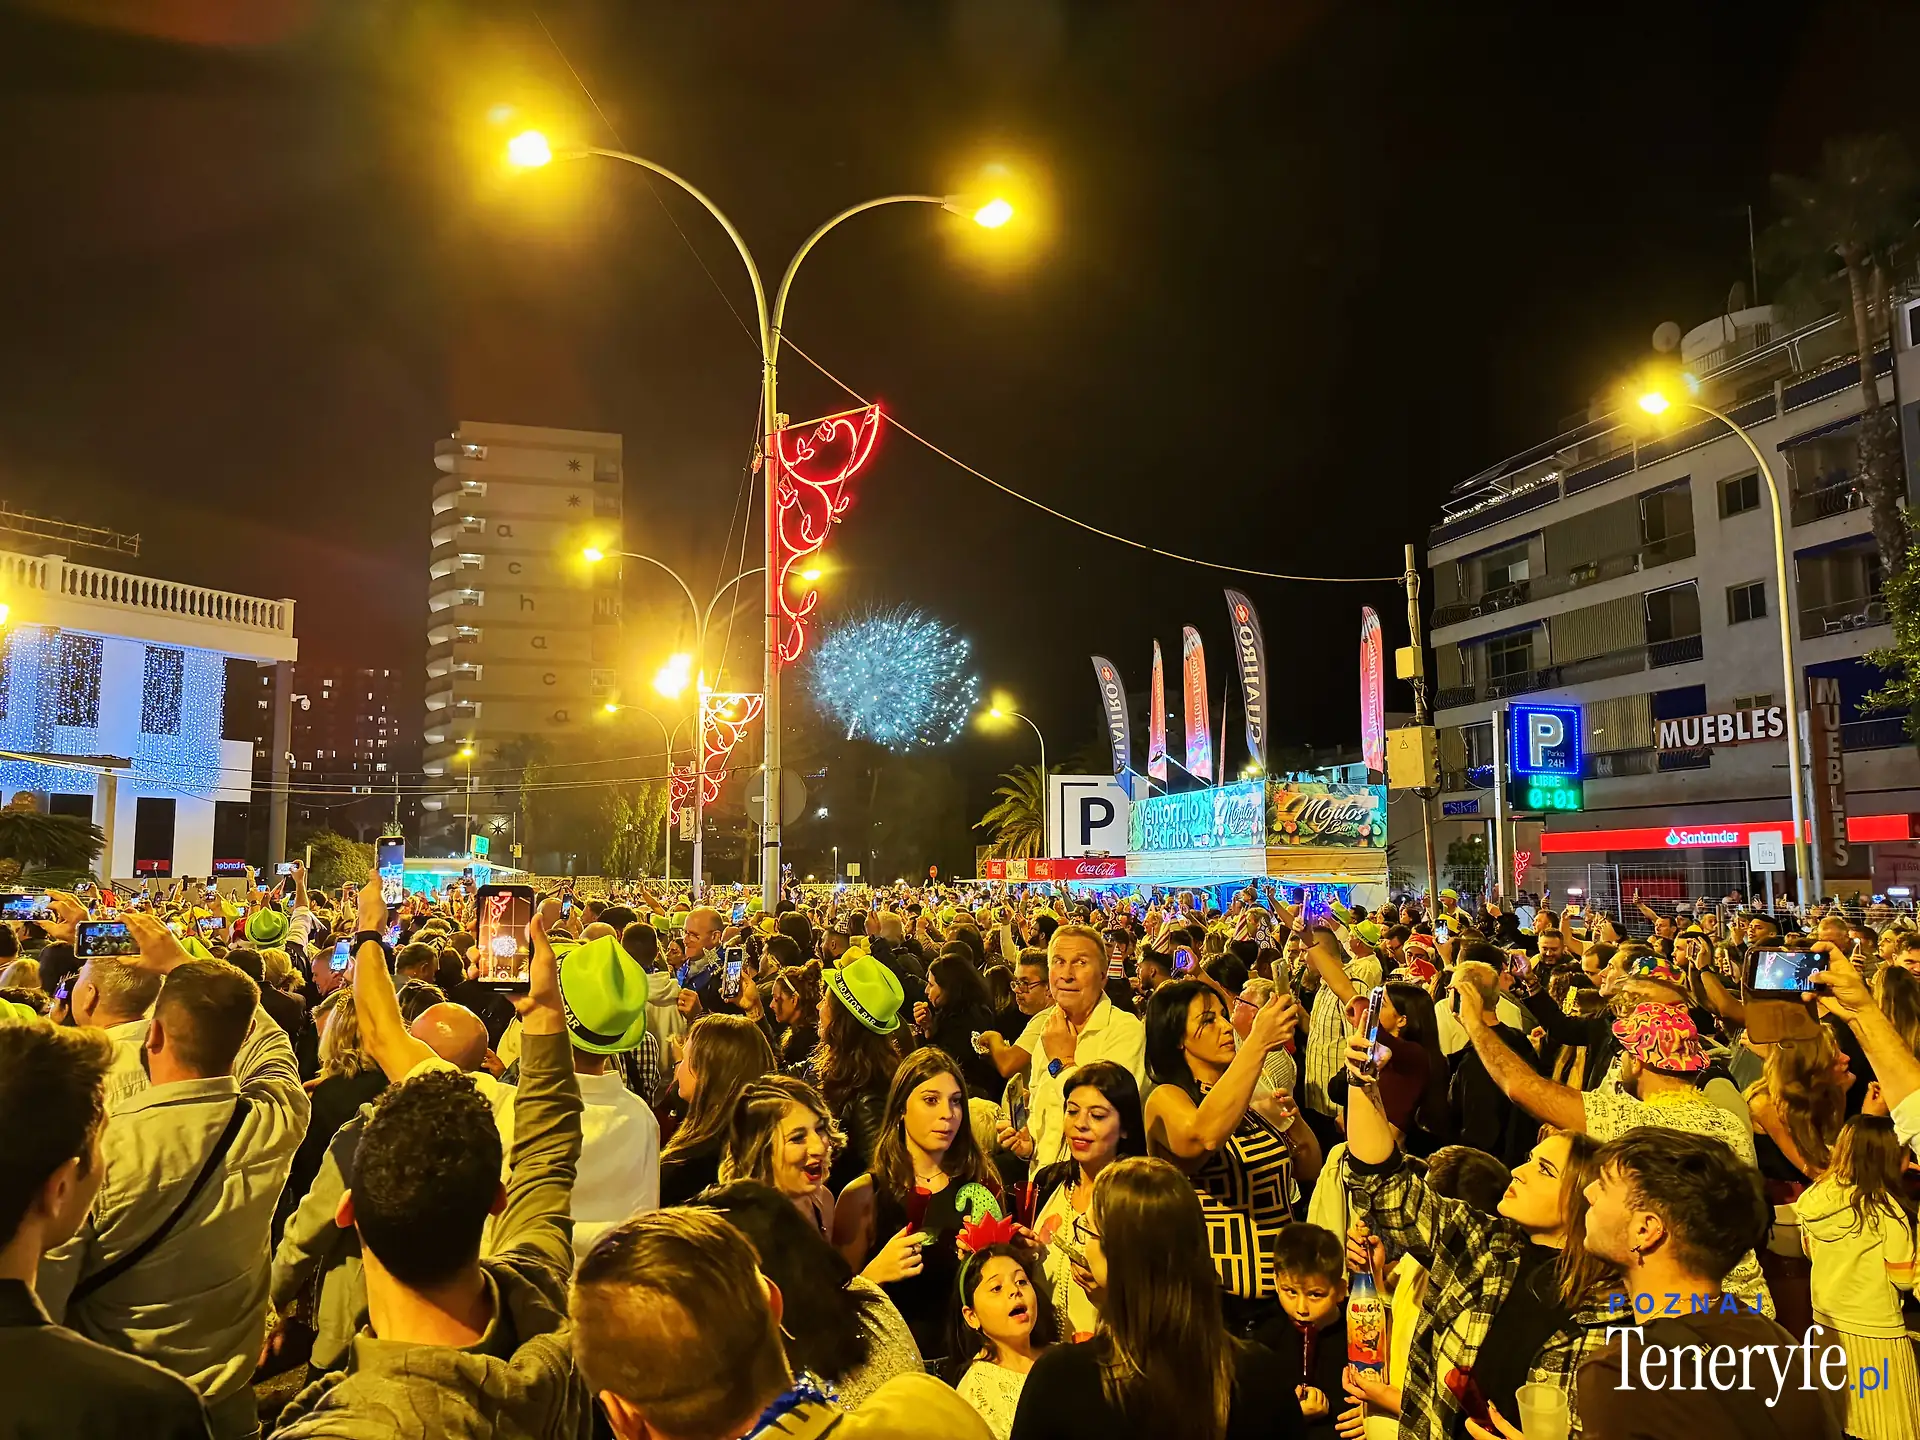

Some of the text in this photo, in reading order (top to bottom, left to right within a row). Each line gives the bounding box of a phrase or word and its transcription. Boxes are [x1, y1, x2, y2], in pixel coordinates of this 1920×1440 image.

[1529, 713, 1563, 767] P
[1659, 707, 1784, 750] MUEBLES
[1548, 759, 1566, 768] 24H
[1817, 678, 1849, 867] MUEBLES
[1533, 775, 1561, 787] LIBRE
[1139, 794, 1199, 826] Ventorrillo
[1285, 795, 1370, 832] Mojitos
[1450, 801, 1478, 814] Silvia
[1529, 788, 1578, 809] 0:01
[1080, 797, 1115, 846] P
[1325, 820, 1352, 834] Bar
[1680, 830, 1739, 845] Santander
[838, 981, 861, 1012] MOJITOS
[861, 1011, 876, 1025] BAR
